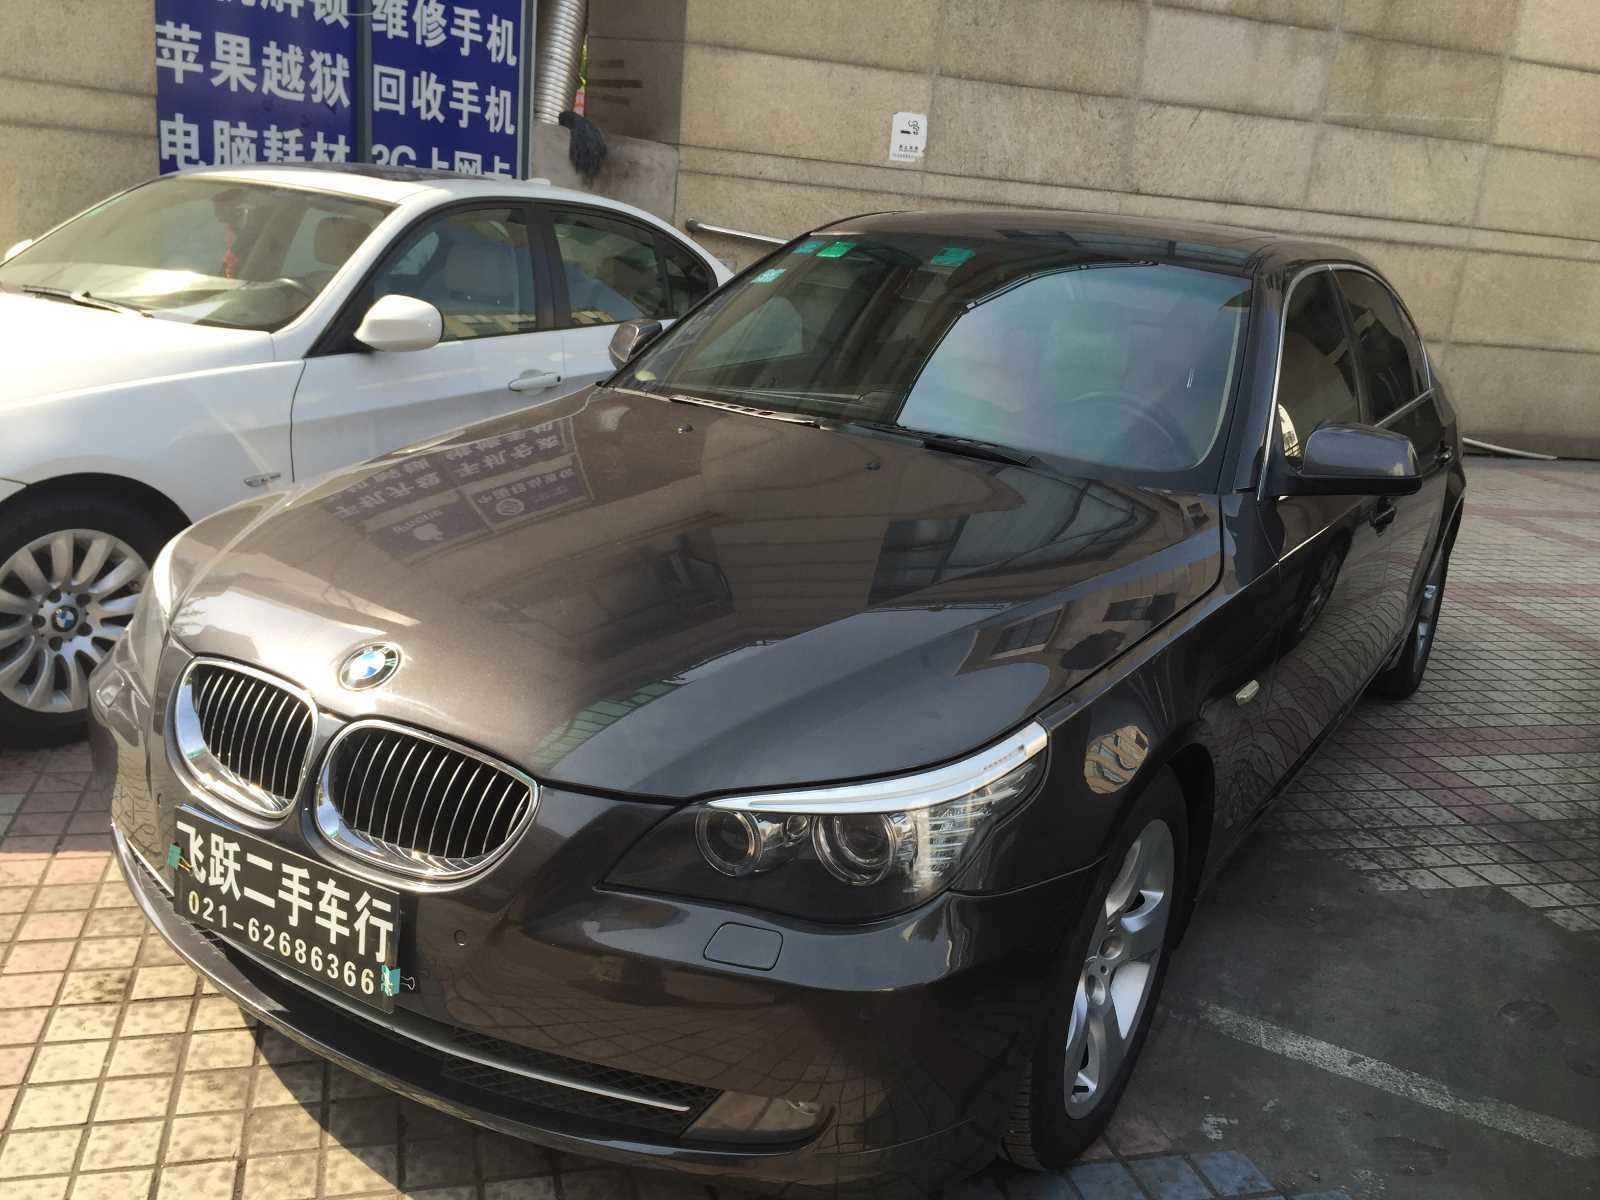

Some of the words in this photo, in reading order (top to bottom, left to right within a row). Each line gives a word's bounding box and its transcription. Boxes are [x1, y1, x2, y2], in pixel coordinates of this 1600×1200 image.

[156, 20, 351, 108] 苹果越狱
[371, 0, 517, 66] 维修手机
[372, 64, 516, 136] 回收手机
[159, 112, 351, 170] 电脑耗材
[176, 819, 394, 963] 飞跃二手车行
[188, 890, 375, 995] 021-62686366
